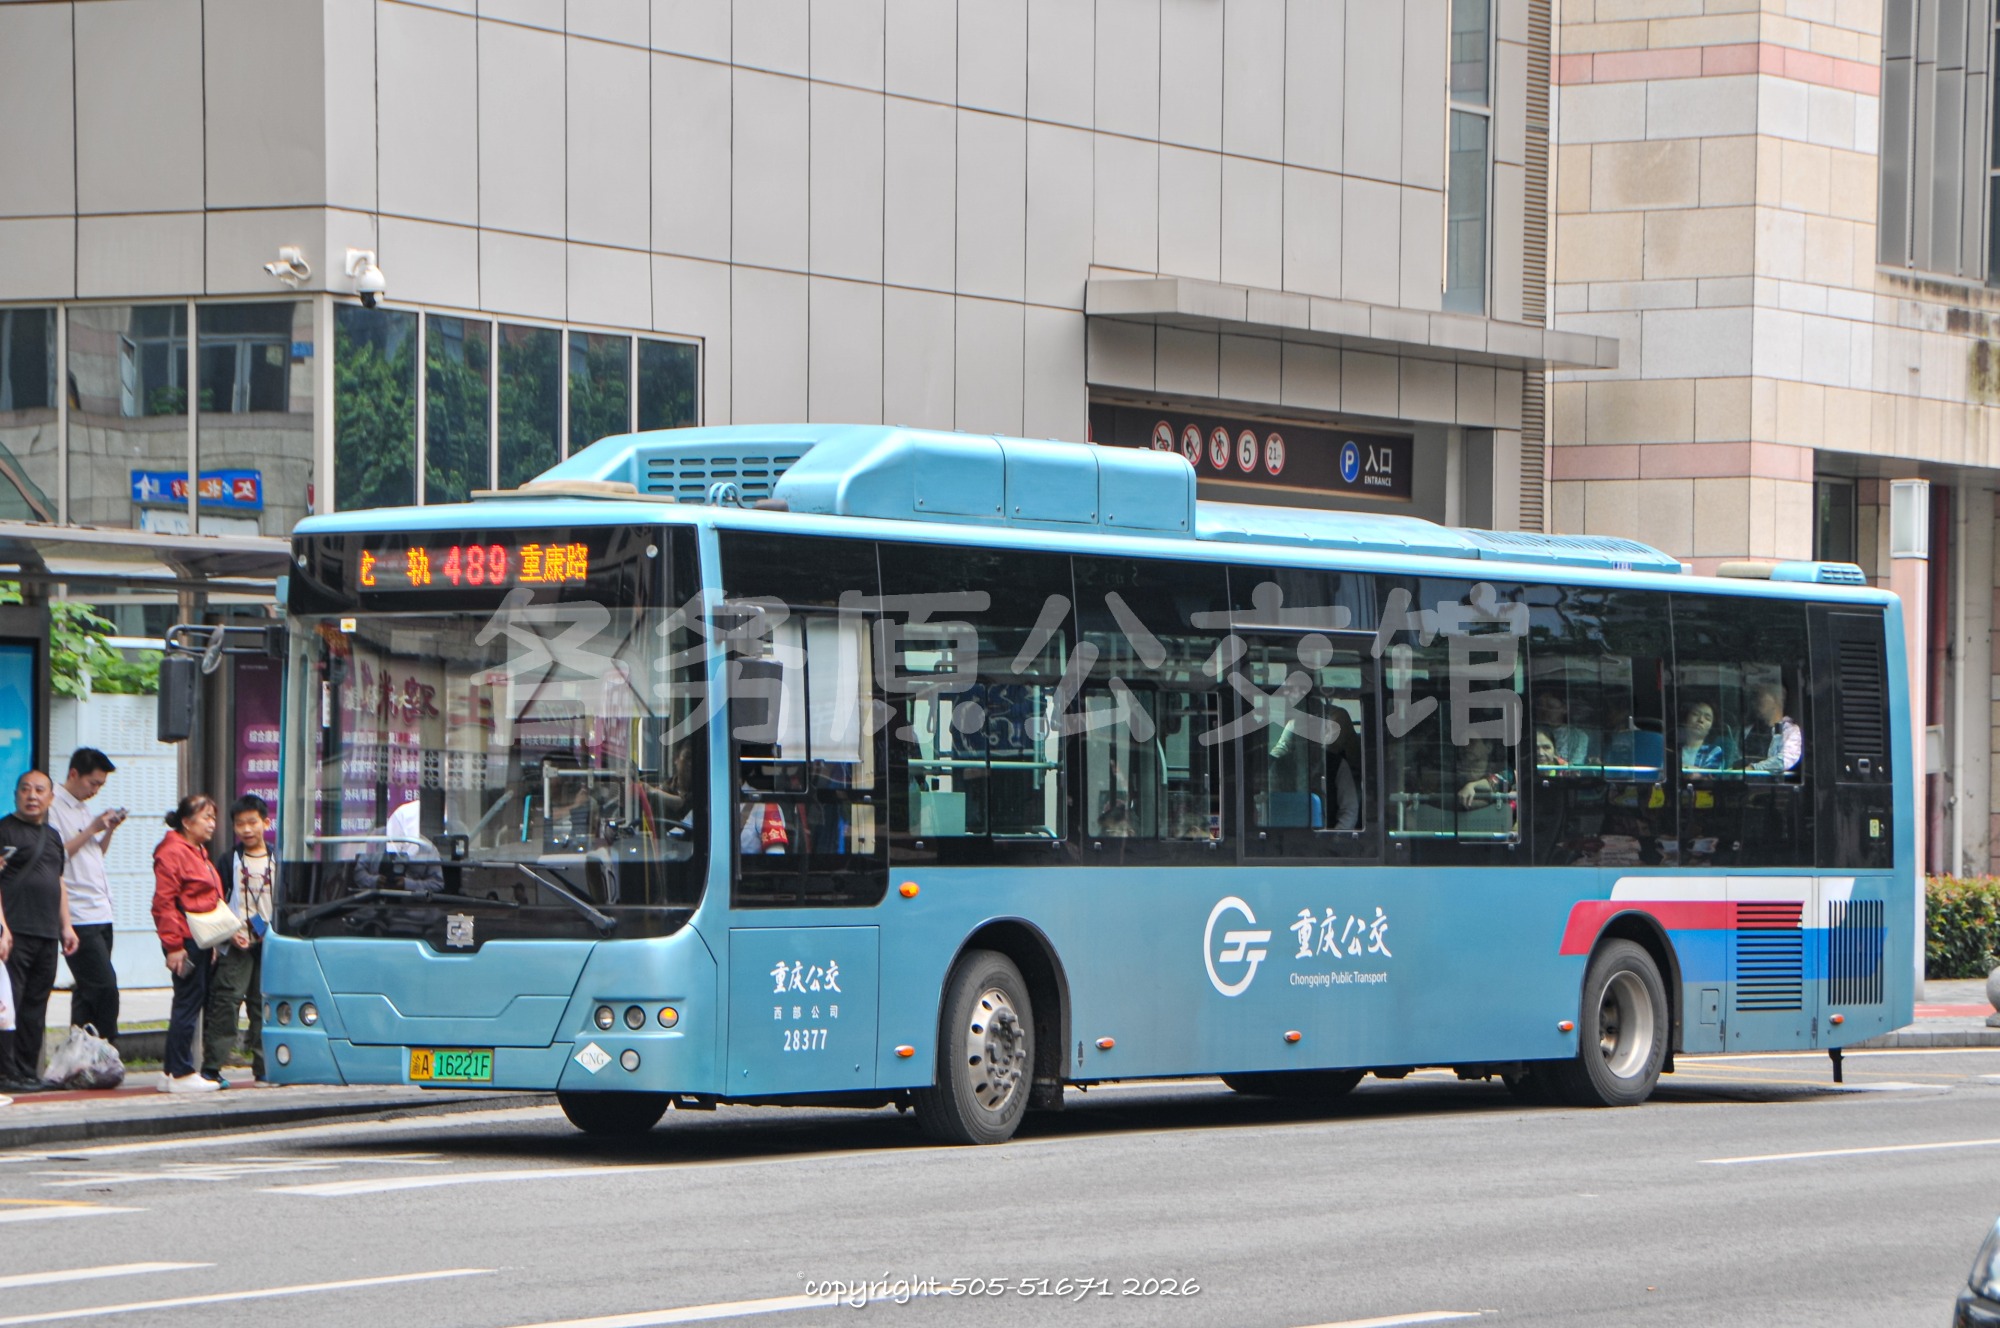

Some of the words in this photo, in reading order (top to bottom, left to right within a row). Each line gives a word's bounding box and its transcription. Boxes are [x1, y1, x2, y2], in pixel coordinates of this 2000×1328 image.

[1243, 440, 1252, 465] 5
[1345, 450, 1355, 473] P
[1364, 444, 1392, 474] 入口
[1364, 475, 1392, 487] ENTRANCE
[443, 543, 507, 586] 489
[519, 542, 588, 583] 重康路
[1289, 906, 1392, 959] 重庆公交
[770, 960, 841, 994] 重庆公交
[1289, 972, 1330, 988] Chongqing
[1331, 971, 1353, 984] Public
[1353, 970, 1388, 986] Transport
[783, 1028, 828, 1051] 28377
[580, 1051, 605, 1067] CNG
